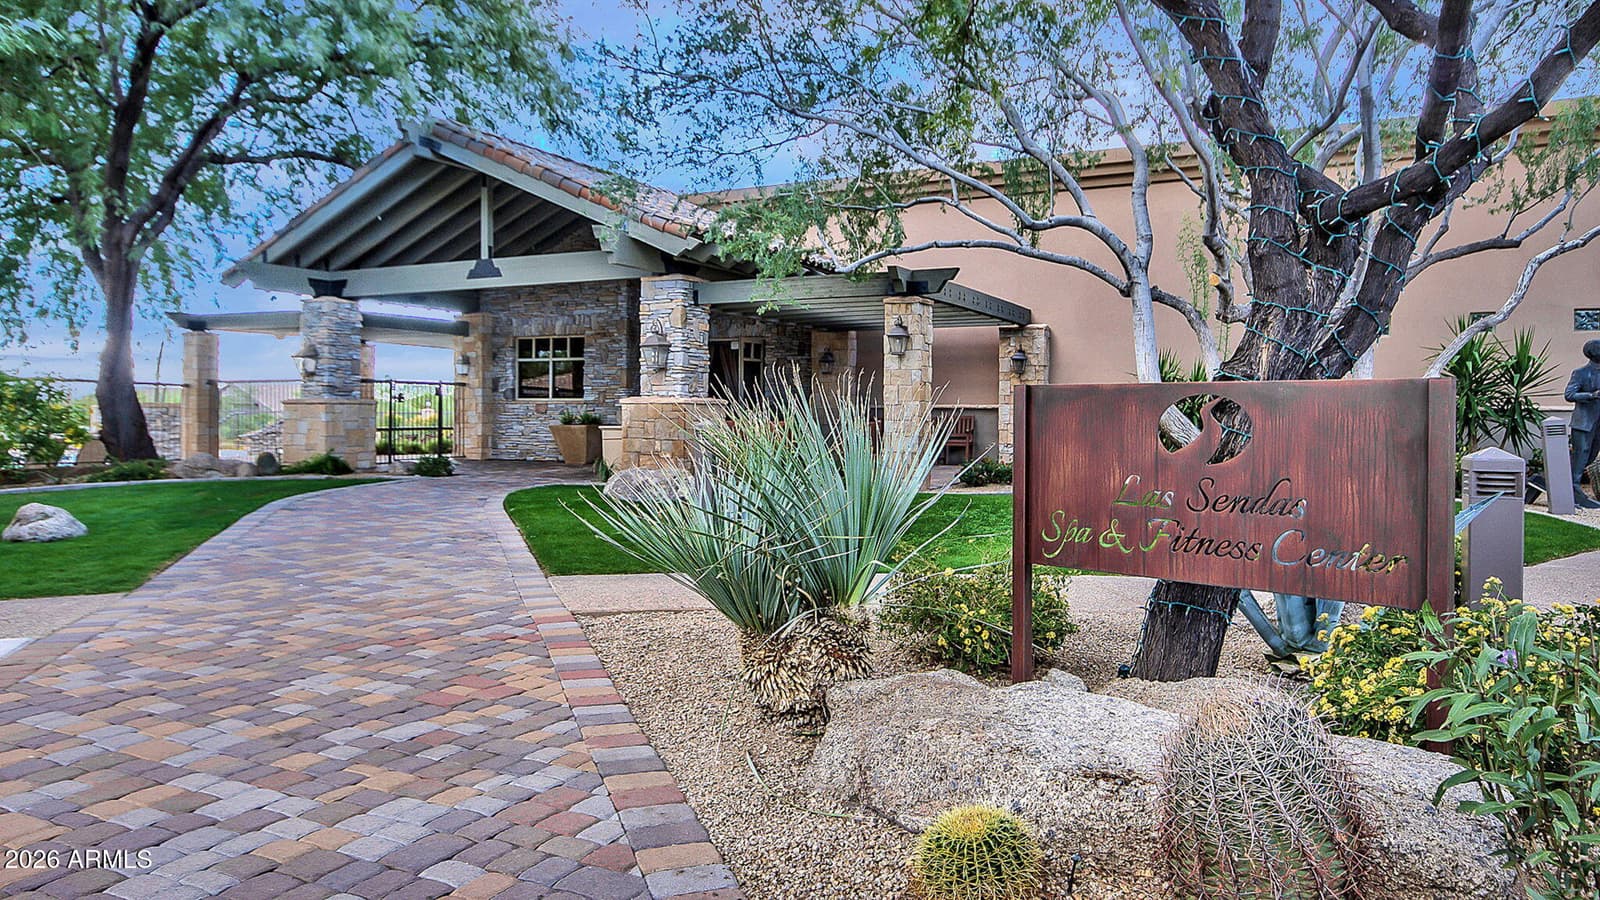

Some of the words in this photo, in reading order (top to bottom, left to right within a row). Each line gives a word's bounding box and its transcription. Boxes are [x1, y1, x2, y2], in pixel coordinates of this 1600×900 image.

[1112, 474, 1175, 509] Las
[1186, 476, 1307, 519] Sendas
[1041, 510, 1093, 558] Spa
[1099, 518, 1134, 553] &
[1139, 518, 1263, 561] Fitness
[1271, 528, 1408, 575] Center
